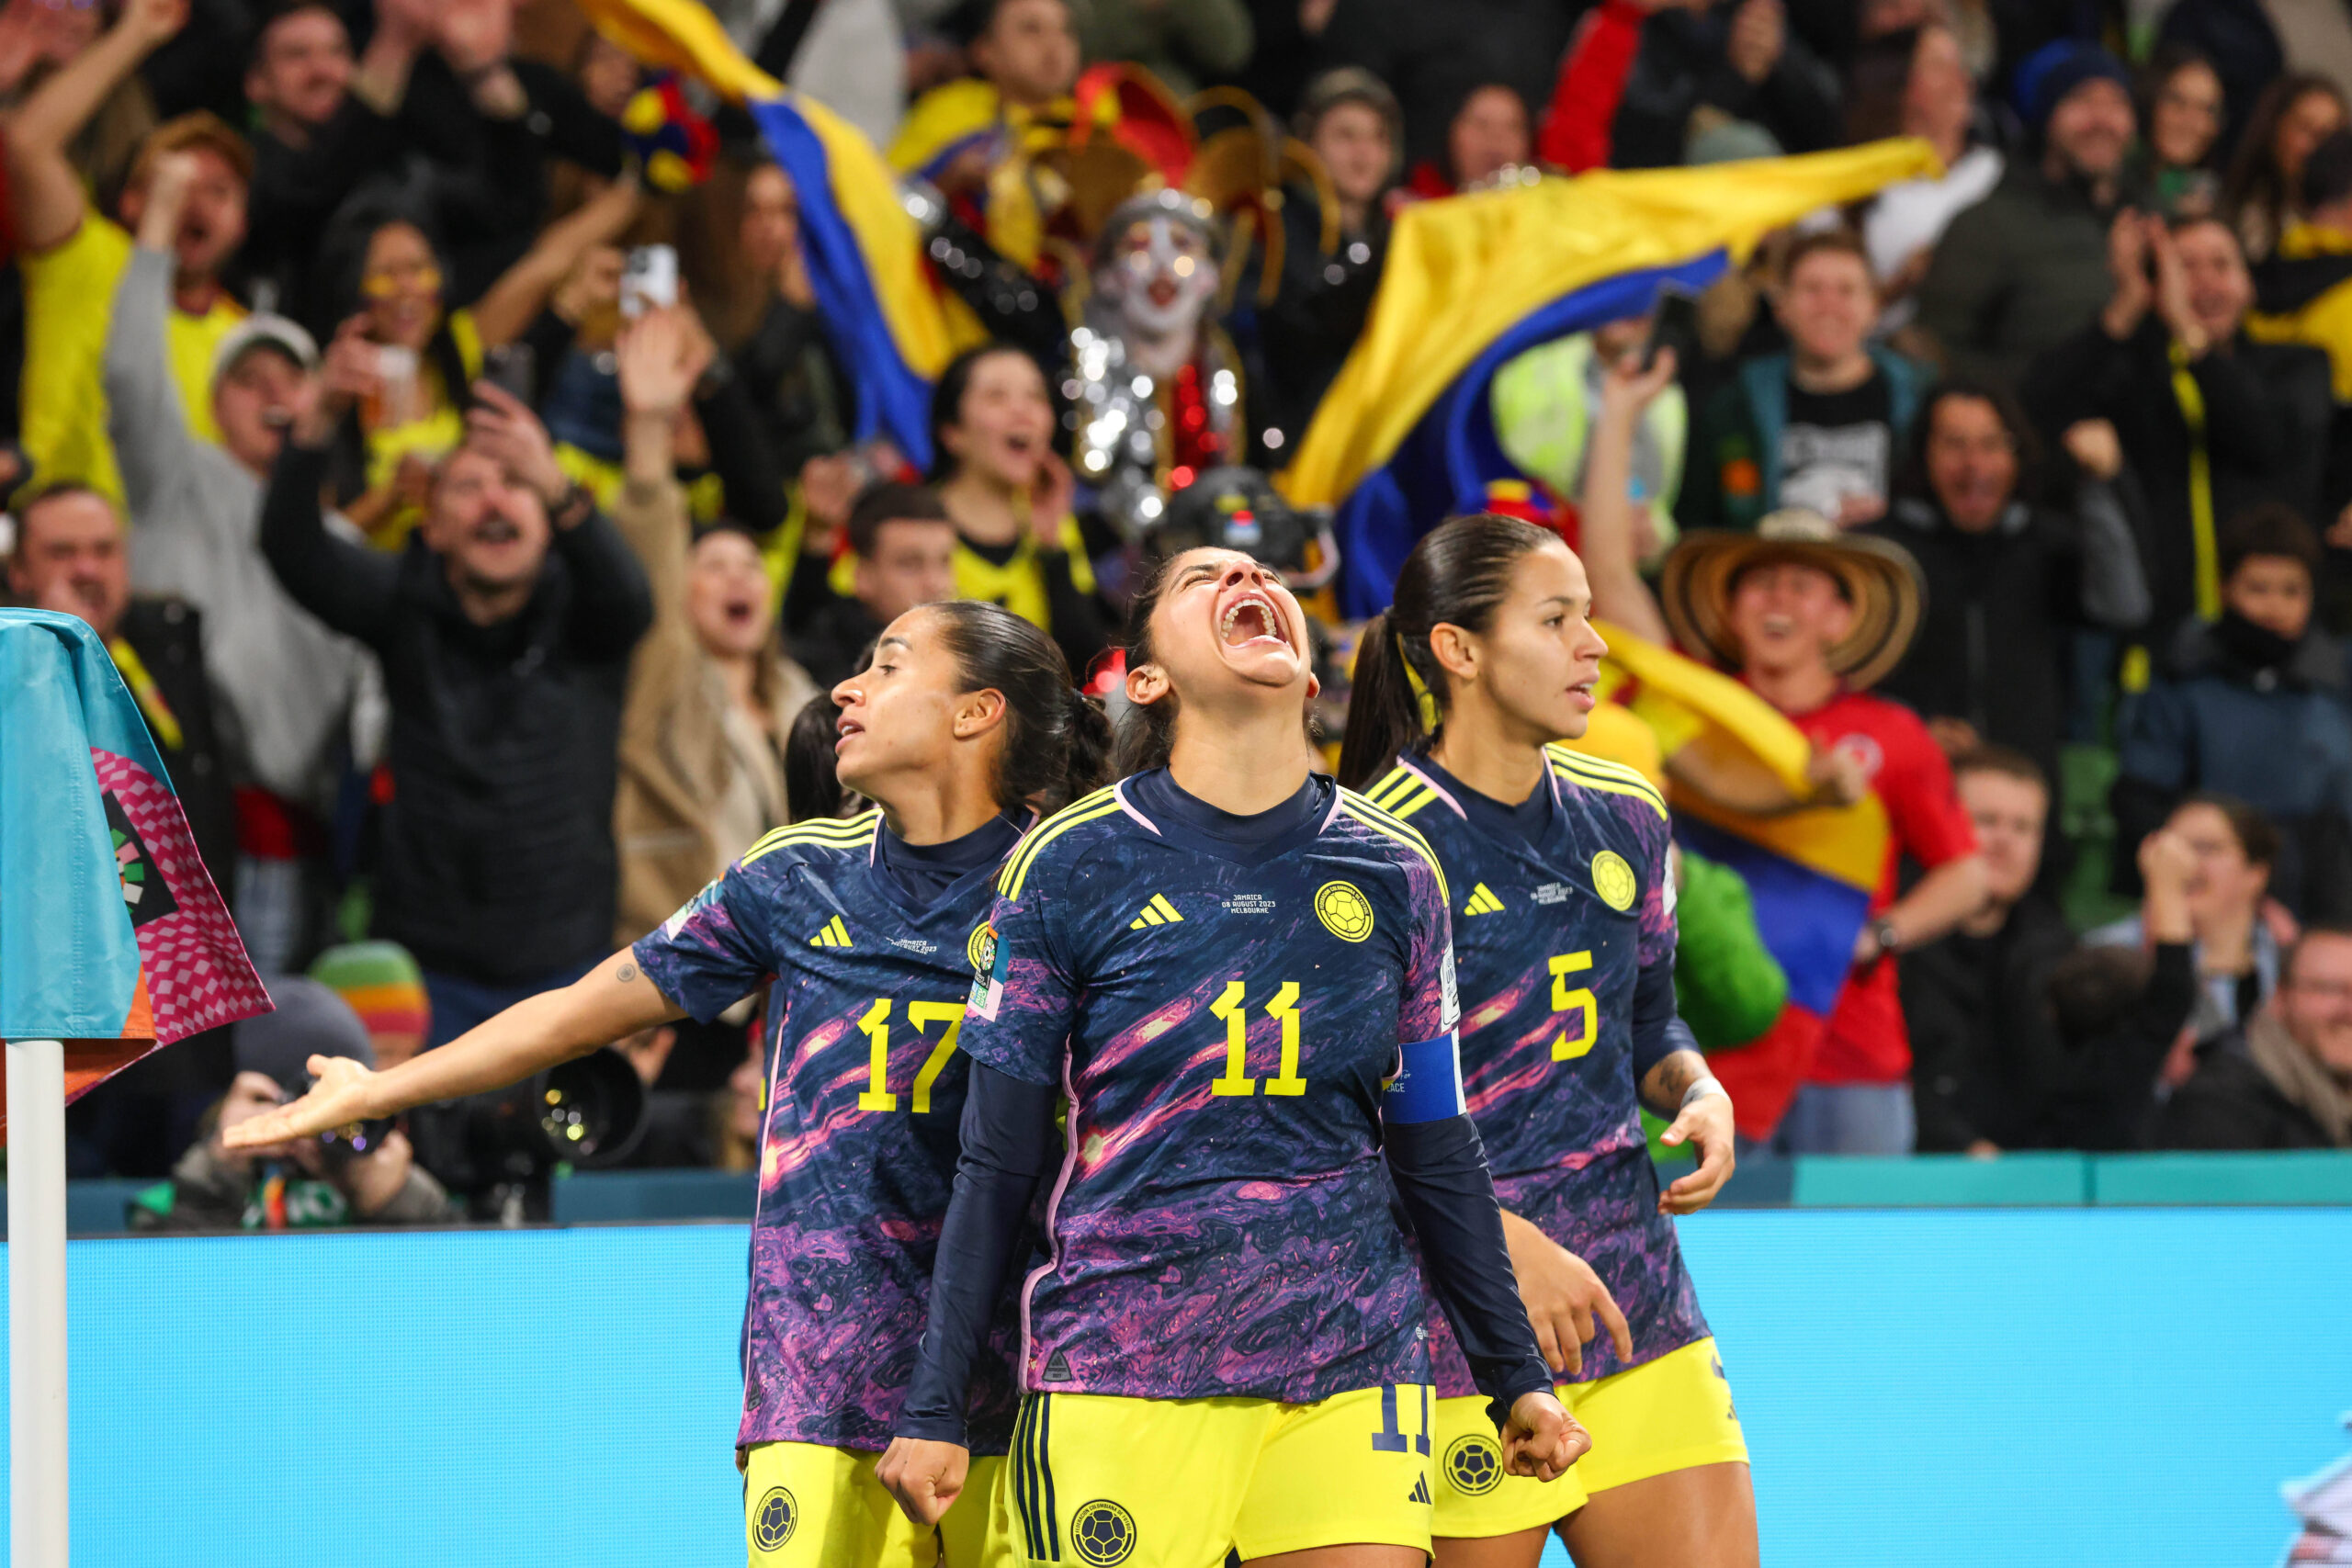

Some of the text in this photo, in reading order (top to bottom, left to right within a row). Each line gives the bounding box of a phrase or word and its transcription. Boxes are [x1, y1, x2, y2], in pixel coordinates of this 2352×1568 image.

[858, 998, 967, 1113] 17
[1210, 982, 1306, 1096] 11
[1549, 951, 1598, 1062] 5
